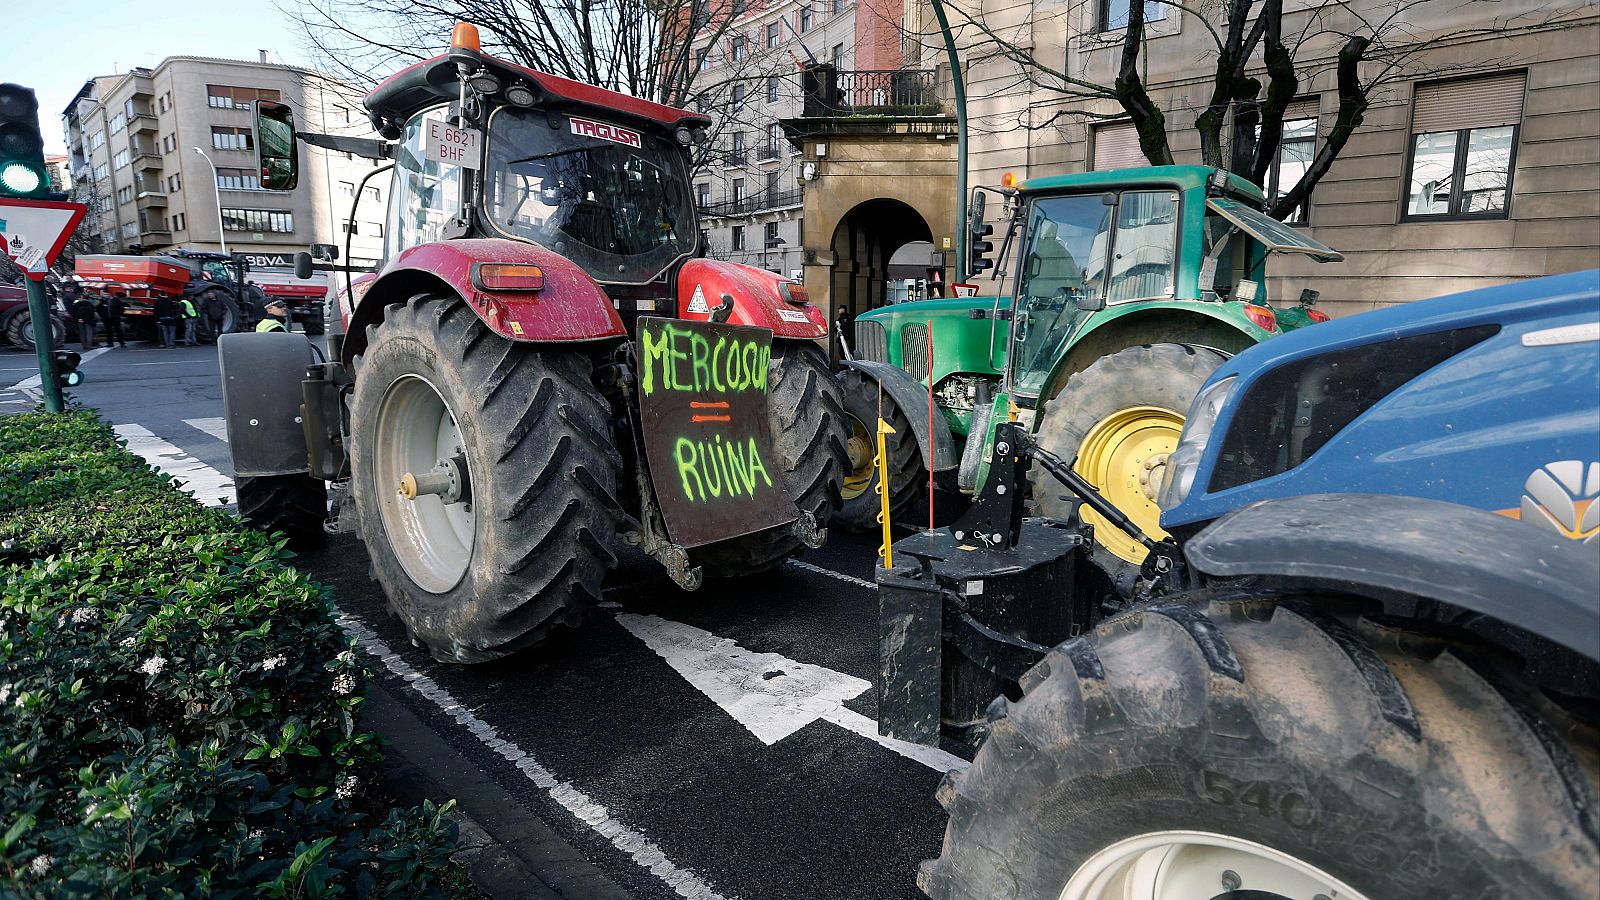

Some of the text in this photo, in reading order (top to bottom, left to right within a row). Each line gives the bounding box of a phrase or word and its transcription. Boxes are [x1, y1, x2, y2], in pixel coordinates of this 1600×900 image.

[571, 118, 640, 146] TAGUSA
[440, 144, 465, 161] BHF
[245, 255, 285, 266] BBVA
[641, 323, 771, 397] MERCOSUR
